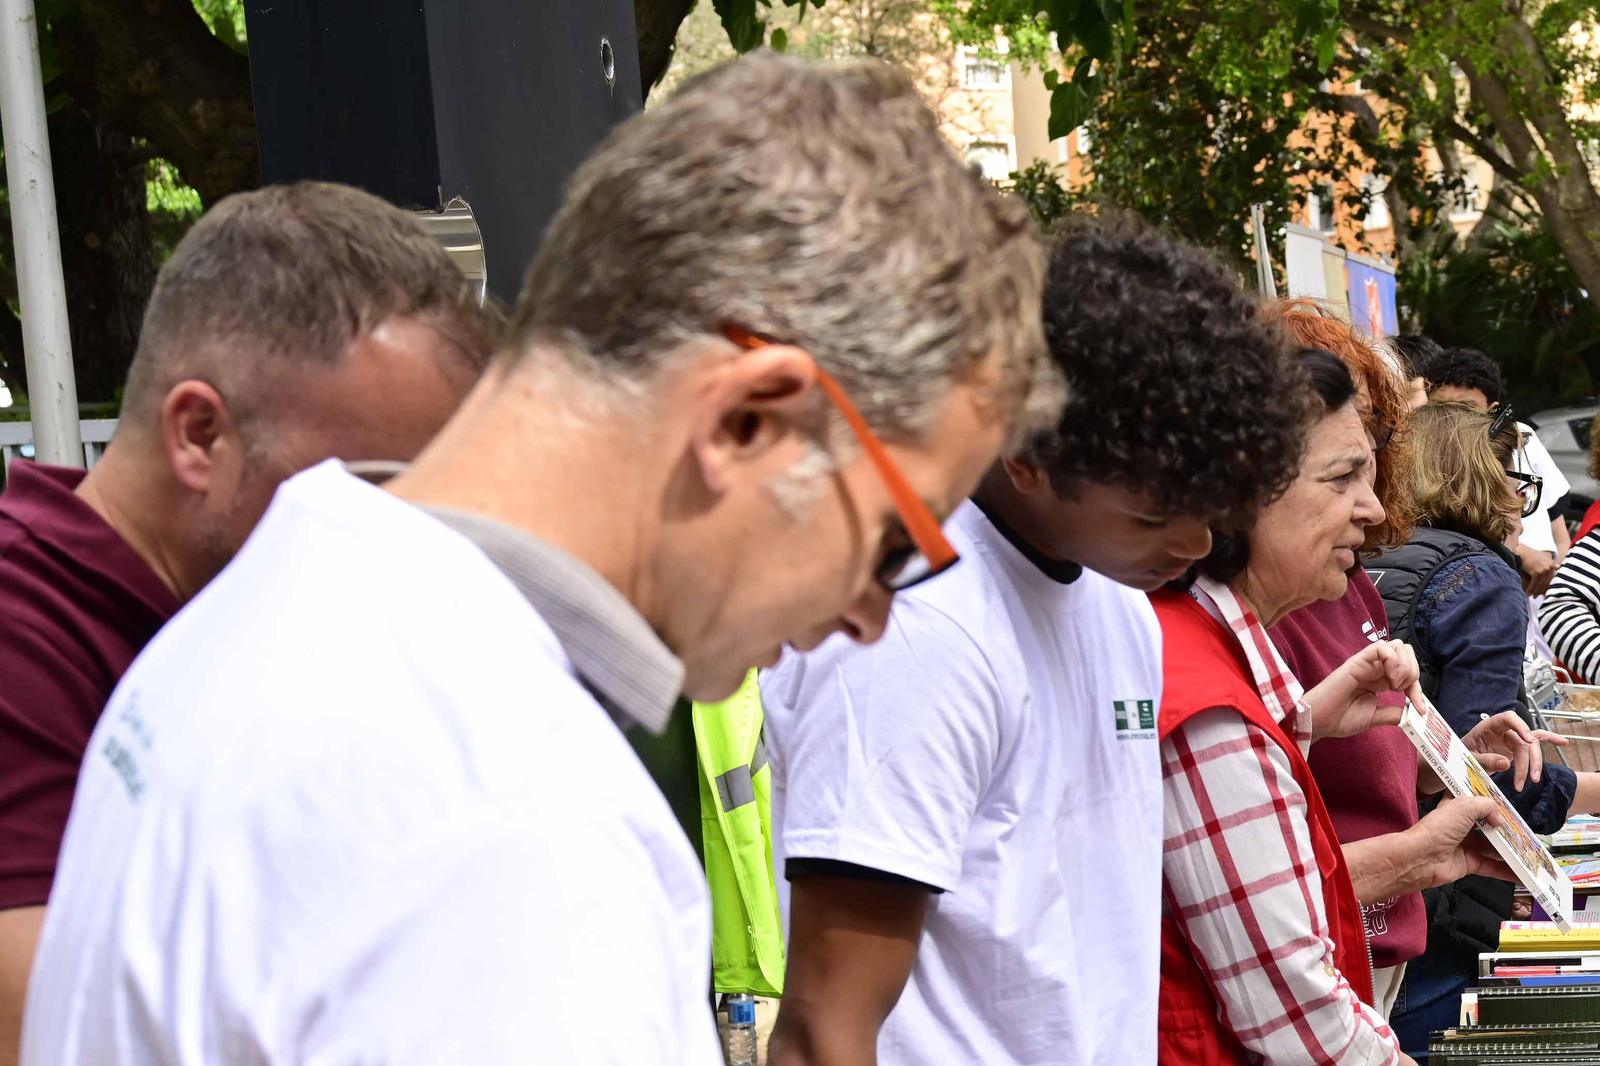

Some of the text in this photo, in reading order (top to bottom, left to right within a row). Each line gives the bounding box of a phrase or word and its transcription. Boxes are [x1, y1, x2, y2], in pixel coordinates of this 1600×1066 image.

[1418, 743, 1439, 767] PUEBLOS
[1435, 764, 1446, 776] DEL
[1443, 774, 1462, 796] PASADO
